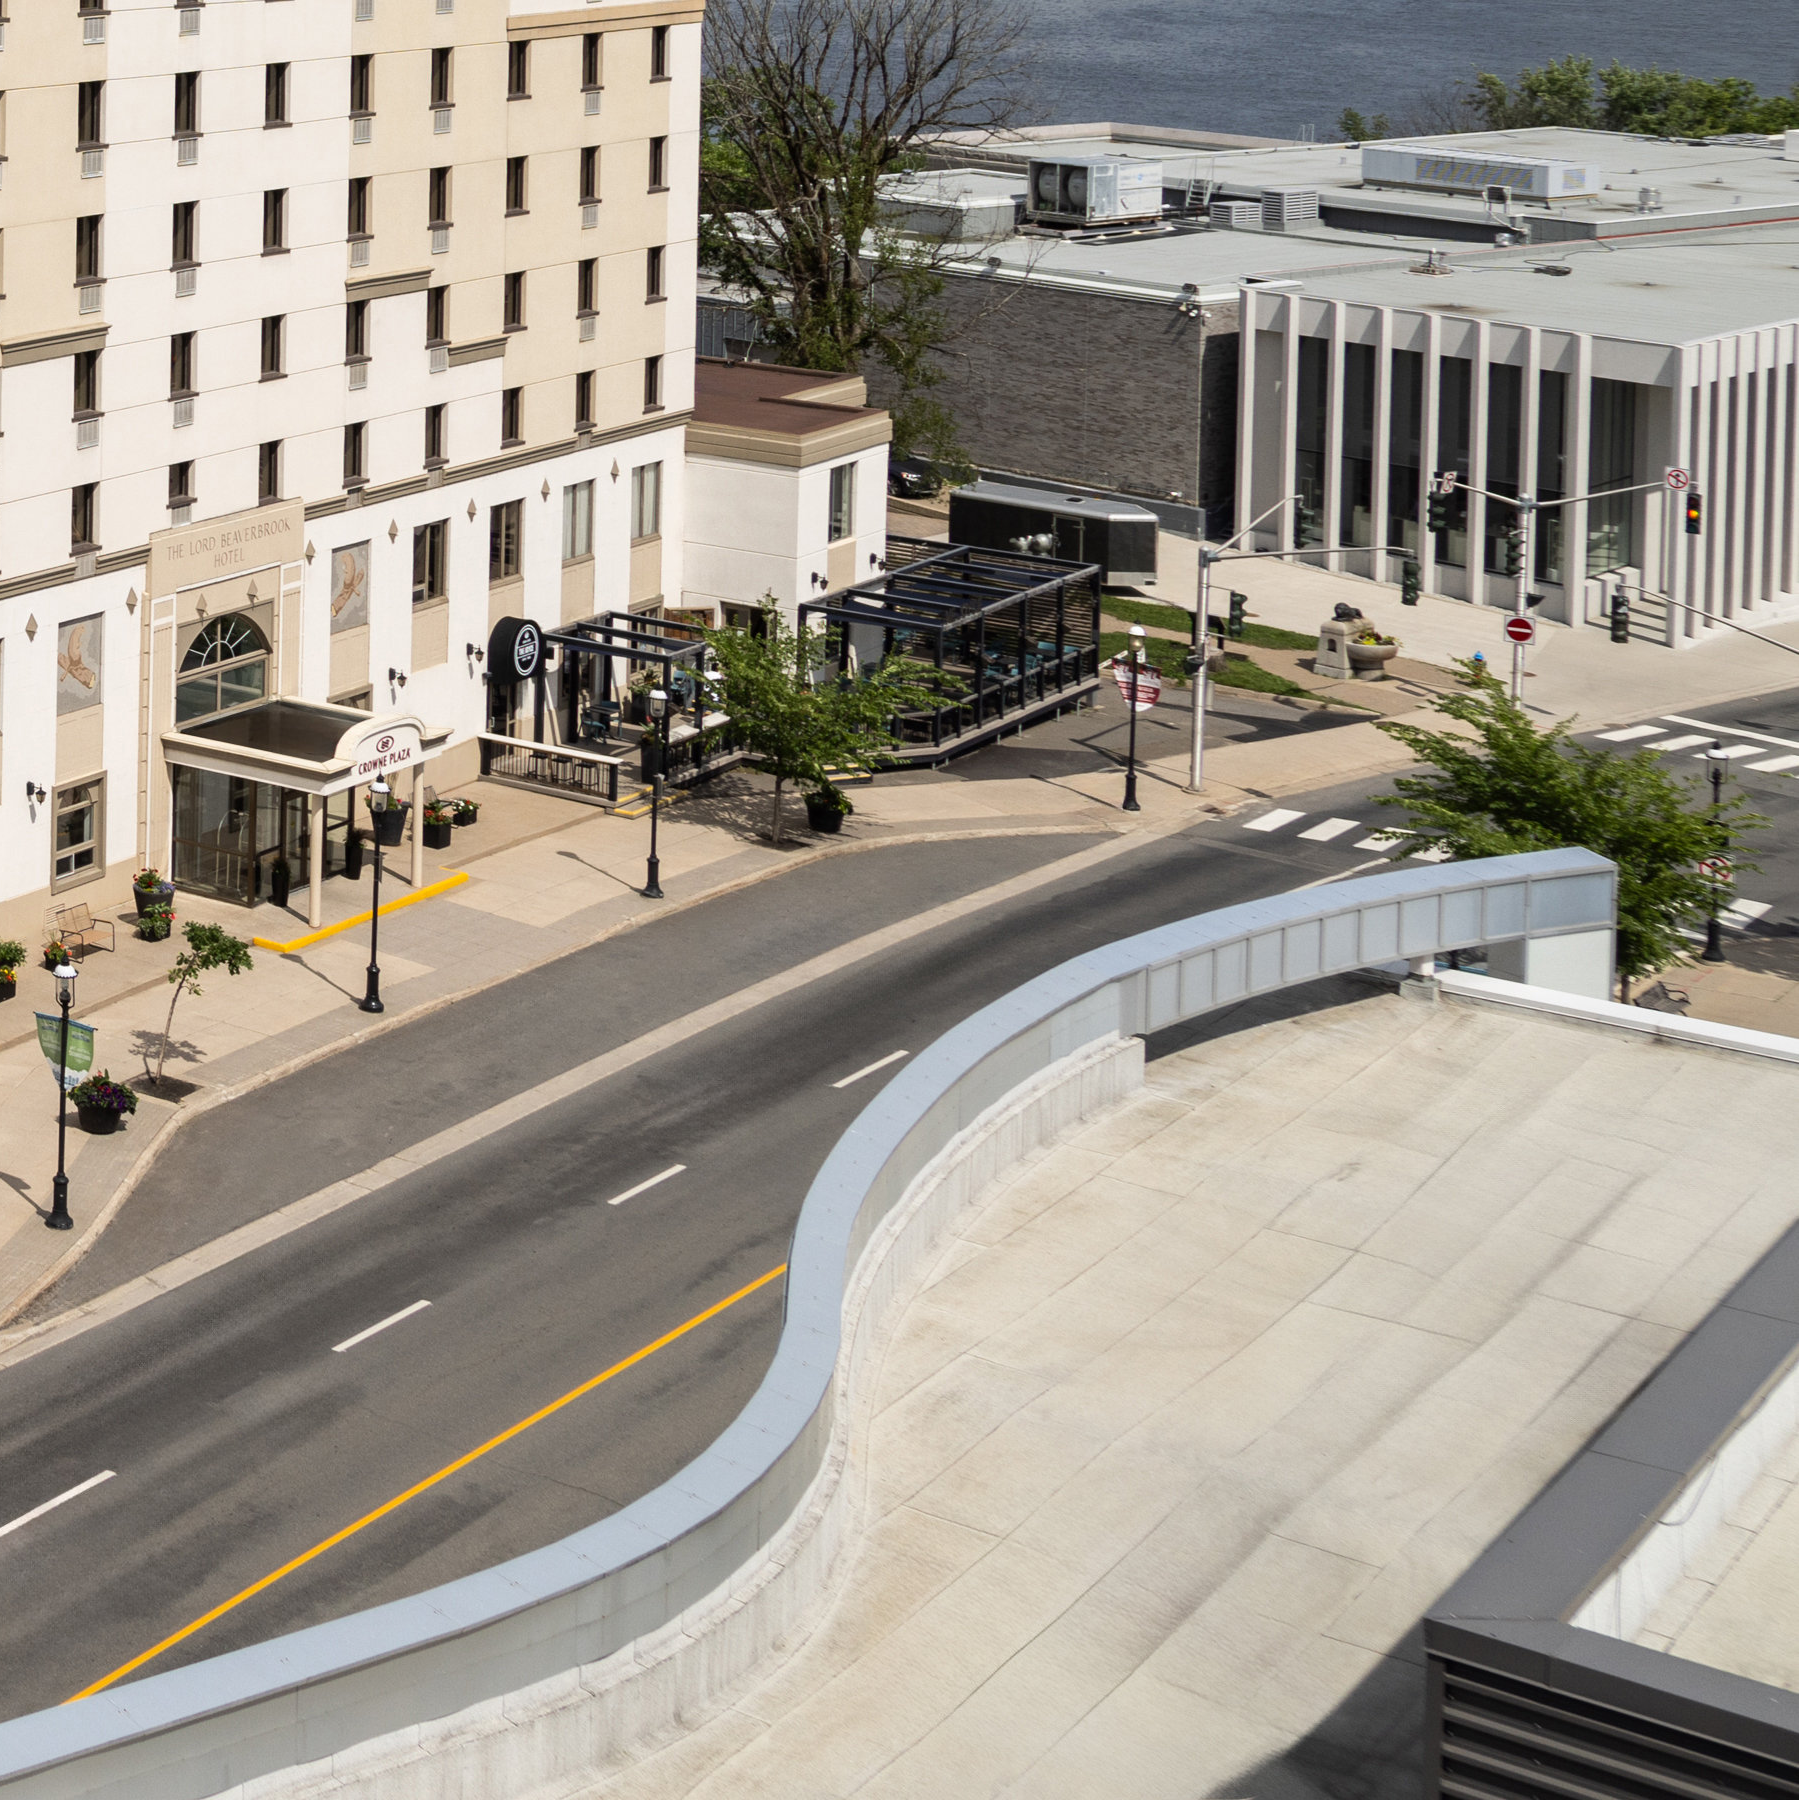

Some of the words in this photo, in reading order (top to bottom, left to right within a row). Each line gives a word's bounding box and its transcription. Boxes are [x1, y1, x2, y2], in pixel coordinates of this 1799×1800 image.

[167, 543, 184, 561] THE
[189, 536, 216, 556] LORD
[220, 517, 291, 549] BEAVERBROOK
[214, 548, 246, 568] HOTEL
[359, 755, 387, 775] CROWNE
[390, 748, 410, 764] PLAZA
